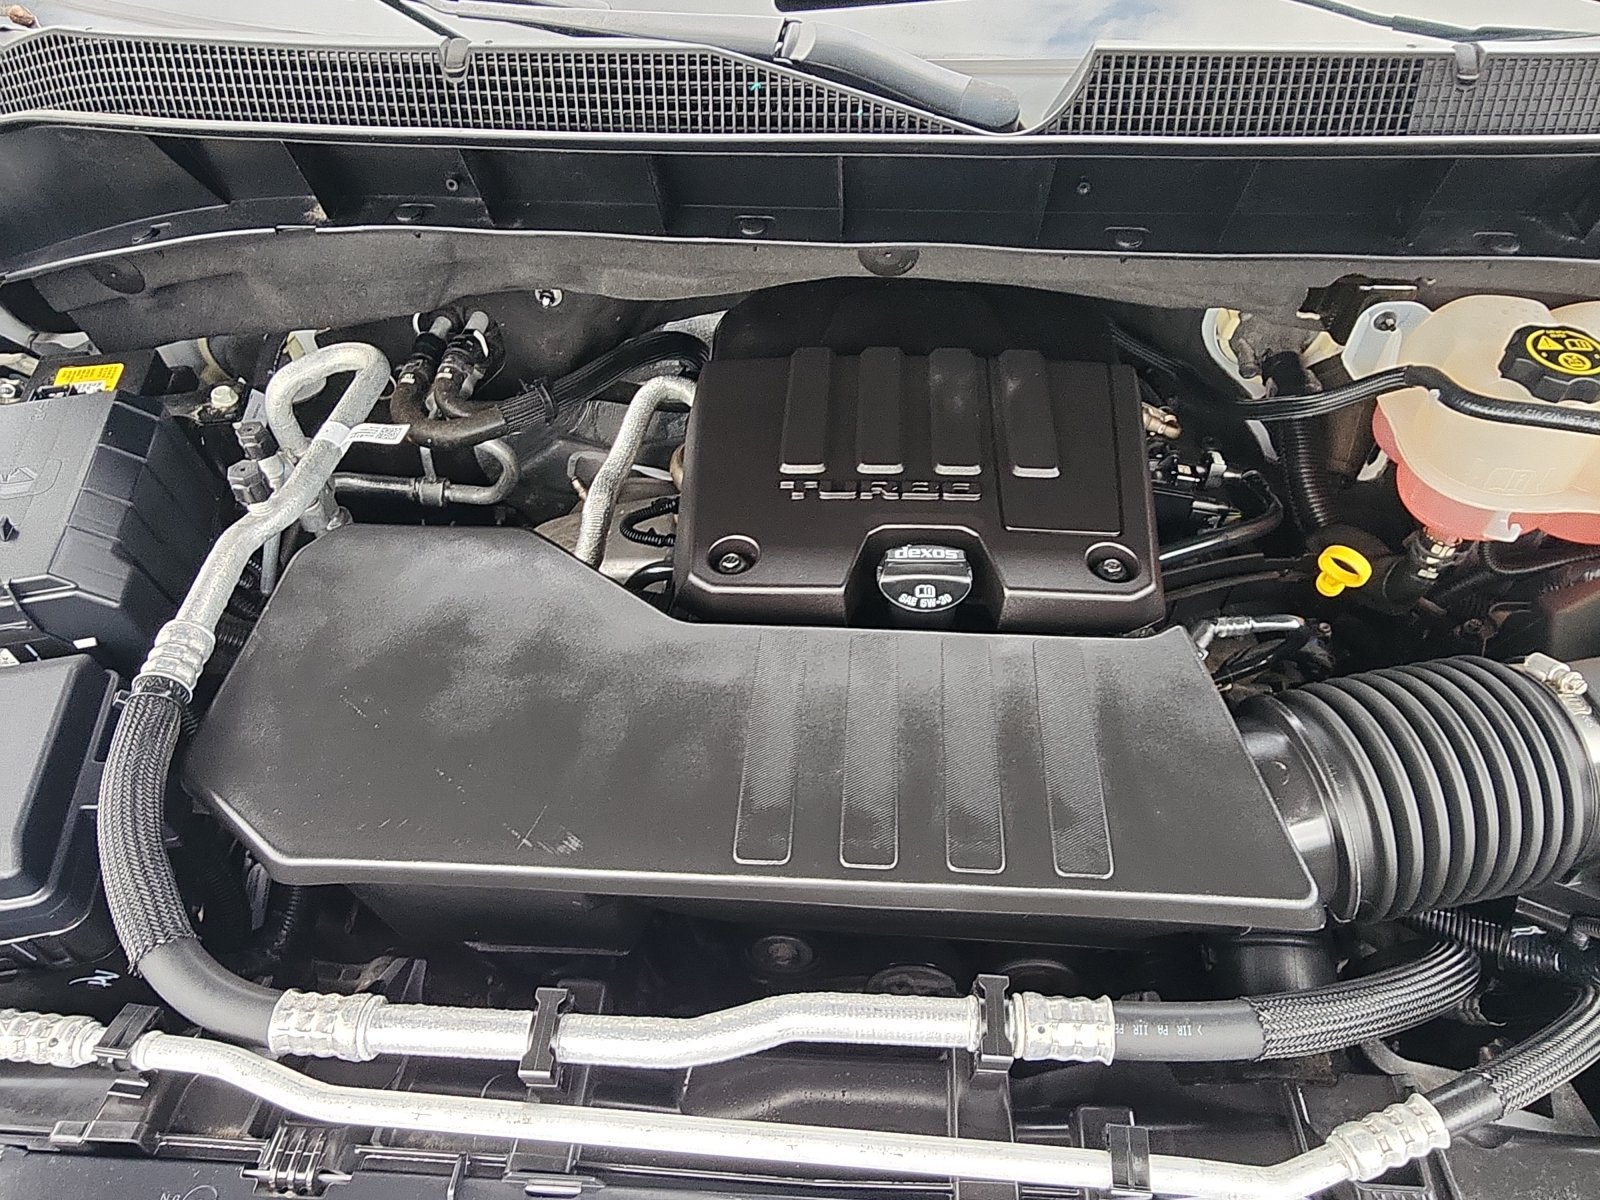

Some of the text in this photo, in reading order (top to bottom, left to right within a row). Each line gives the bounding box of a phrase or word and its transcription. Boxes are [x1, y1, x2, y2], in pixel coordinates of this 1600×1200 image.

[779, 480, 981, 501] TURBO
[894, 544, 959, 559] dexos
[898, 593, 953, 608] SAE 5W-30
